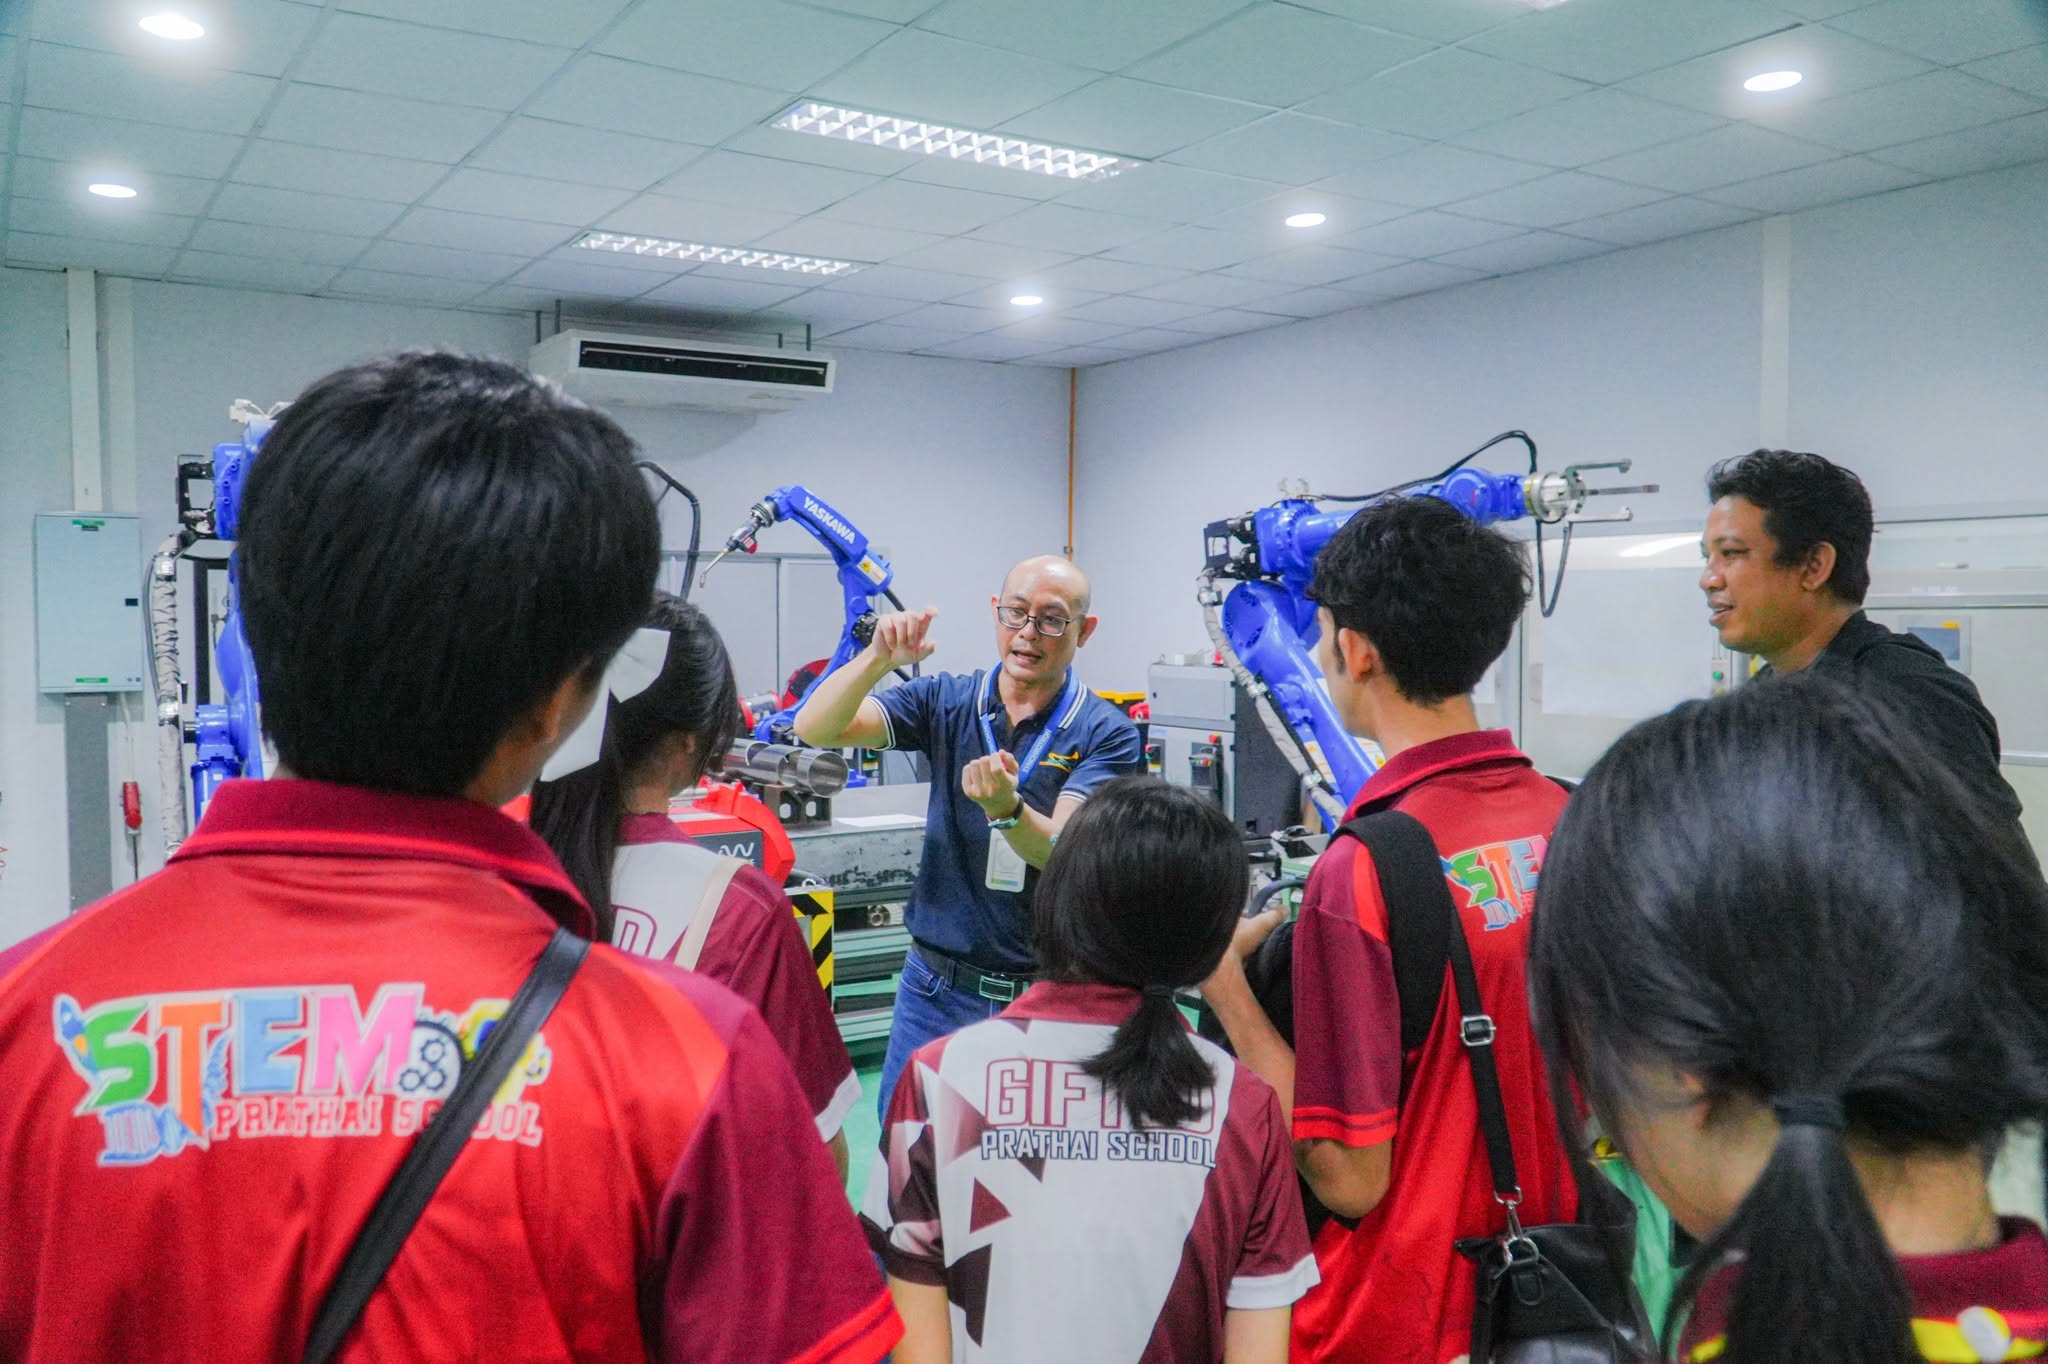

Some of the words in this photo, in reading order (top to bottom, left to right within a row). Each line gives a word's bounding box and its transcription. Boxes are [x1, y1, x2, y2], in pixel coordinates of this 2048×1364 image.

[803, 496, 856, 544] YASKAWA
[1448, 835, 1548, 918] STE
[73, 983, 425, 1147] STEM
[210, 1096, 384, 1140] PRATHAI
[981, 1129, 1098, 1160] PRATHAI
[1107, 1130, 1216, 1168] SCHOOL
